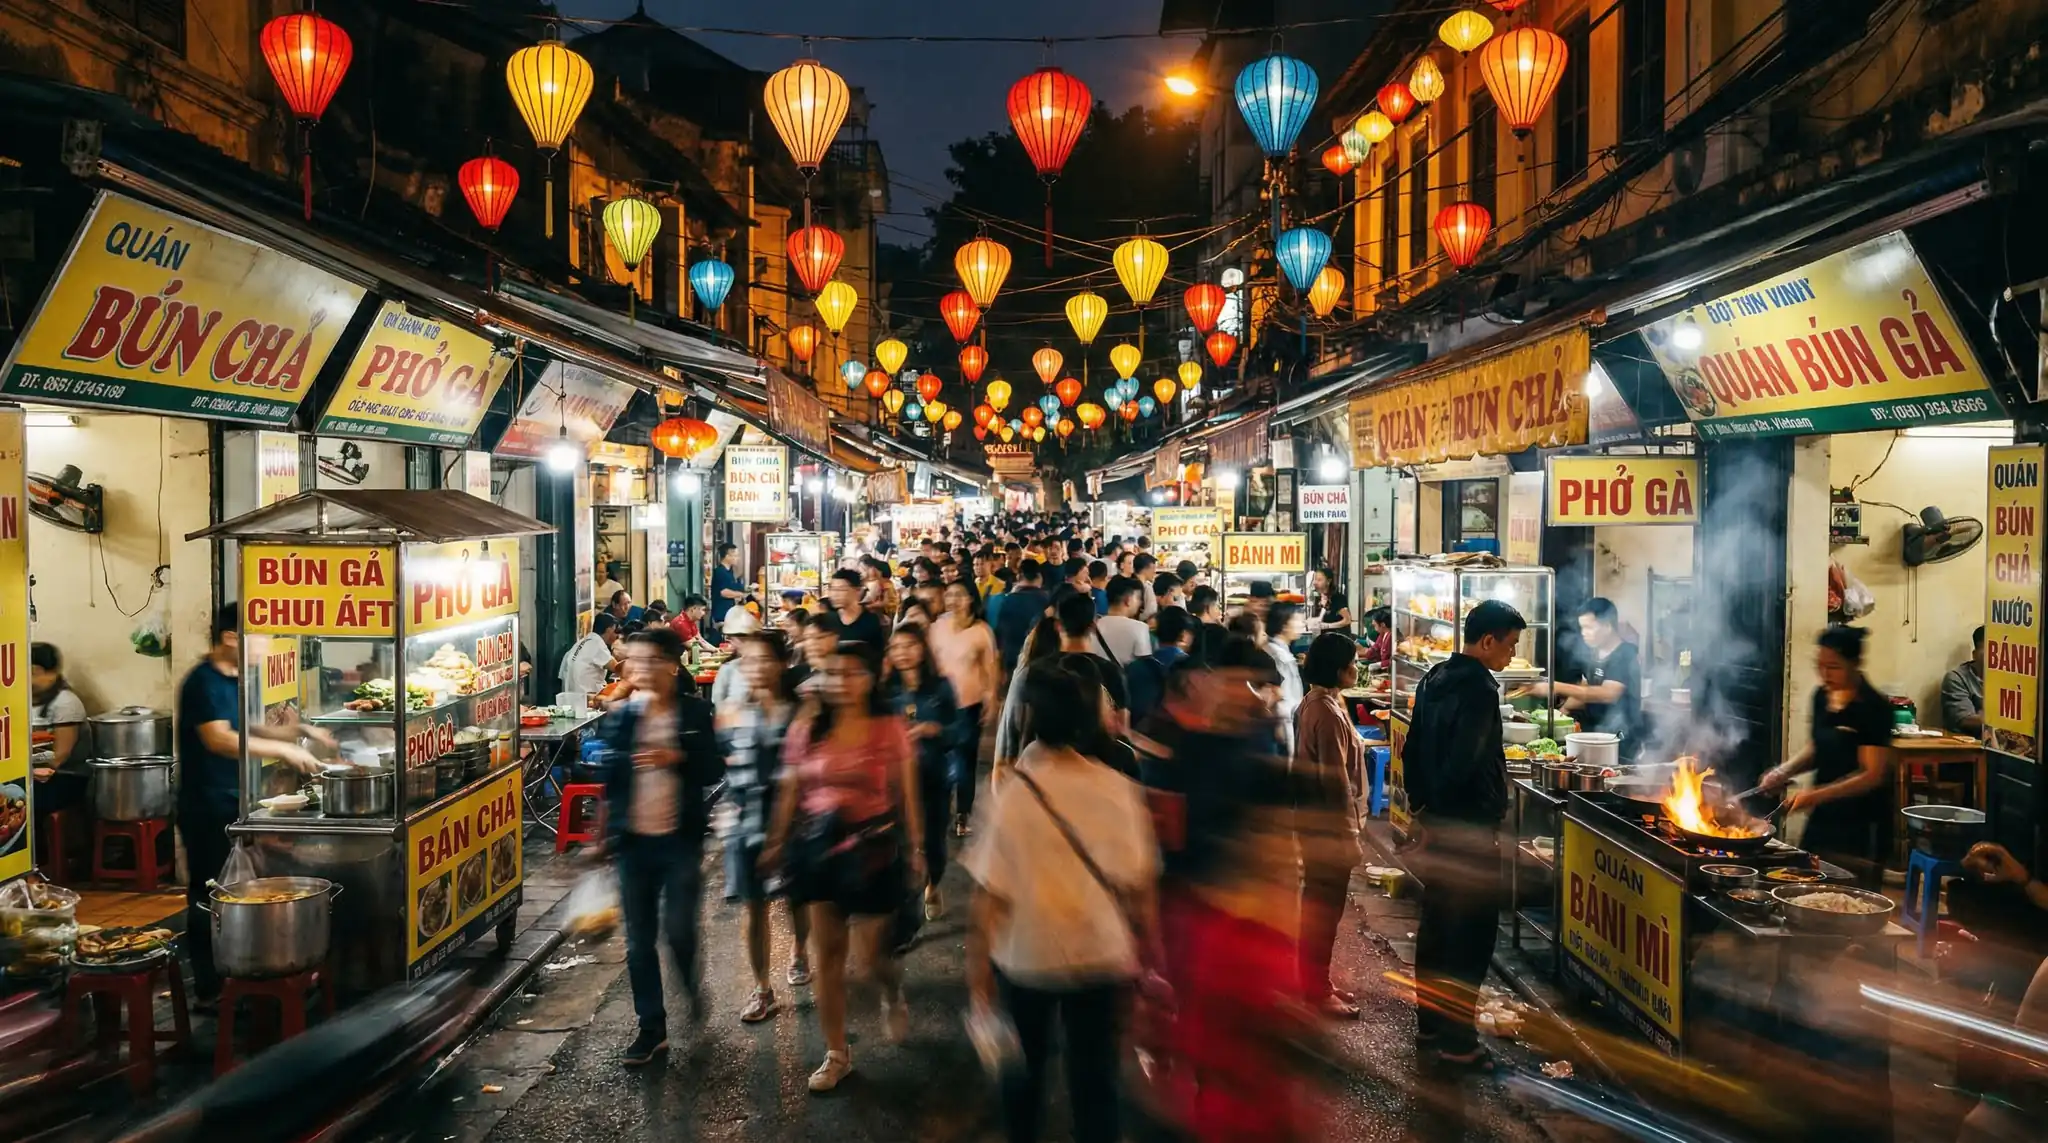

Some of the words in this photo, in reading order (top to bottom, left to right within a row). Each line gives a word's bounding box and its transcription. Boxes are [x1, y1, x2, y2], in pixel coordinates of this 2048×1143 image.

[105, 222, 190, 271] QUÁN
[62, 279, 223, 376] BÚN
[1699, 336, 1798, 407] QUÁN
[1787, 315, 1888, 392] BÚN
[1879, 287, 1966, 380] GẢ
[356, 340, 450, 400] PHỞ
[1379, 394, 1427, 461] QUÁN
[1453, 375, 1500, 441] BÚN
[1507, 345, 1570, 432] CHẢ
[1559, 464, 1634, 516] PHỞ
[1645, 470, 1694, 516] GÀ
[1994, 457, 2038, 491] QUÁN
[1995, 500, 2035, 537] BÚN
[258, 552, 328, 586] BÚN
[339, 550, 386, 587] GẢ
[1229, 540, 1275, 565] BÁNH
[1994, 542, 2032, 586] CHẢ
[335, 594, 395, 628] ÁFT
[1988, 636, 2037, 677] BÁNH
[1999, 684, 2023, 721] MÌ
[438, 713, 456, 756] GÀ
[418, 816, 470, 876] BÁN
[477, 778, 516, 840] CHẢ
[1594, 848, 1644, 896] QUÁN
[1636, 914, 1670, 988] MÌ
